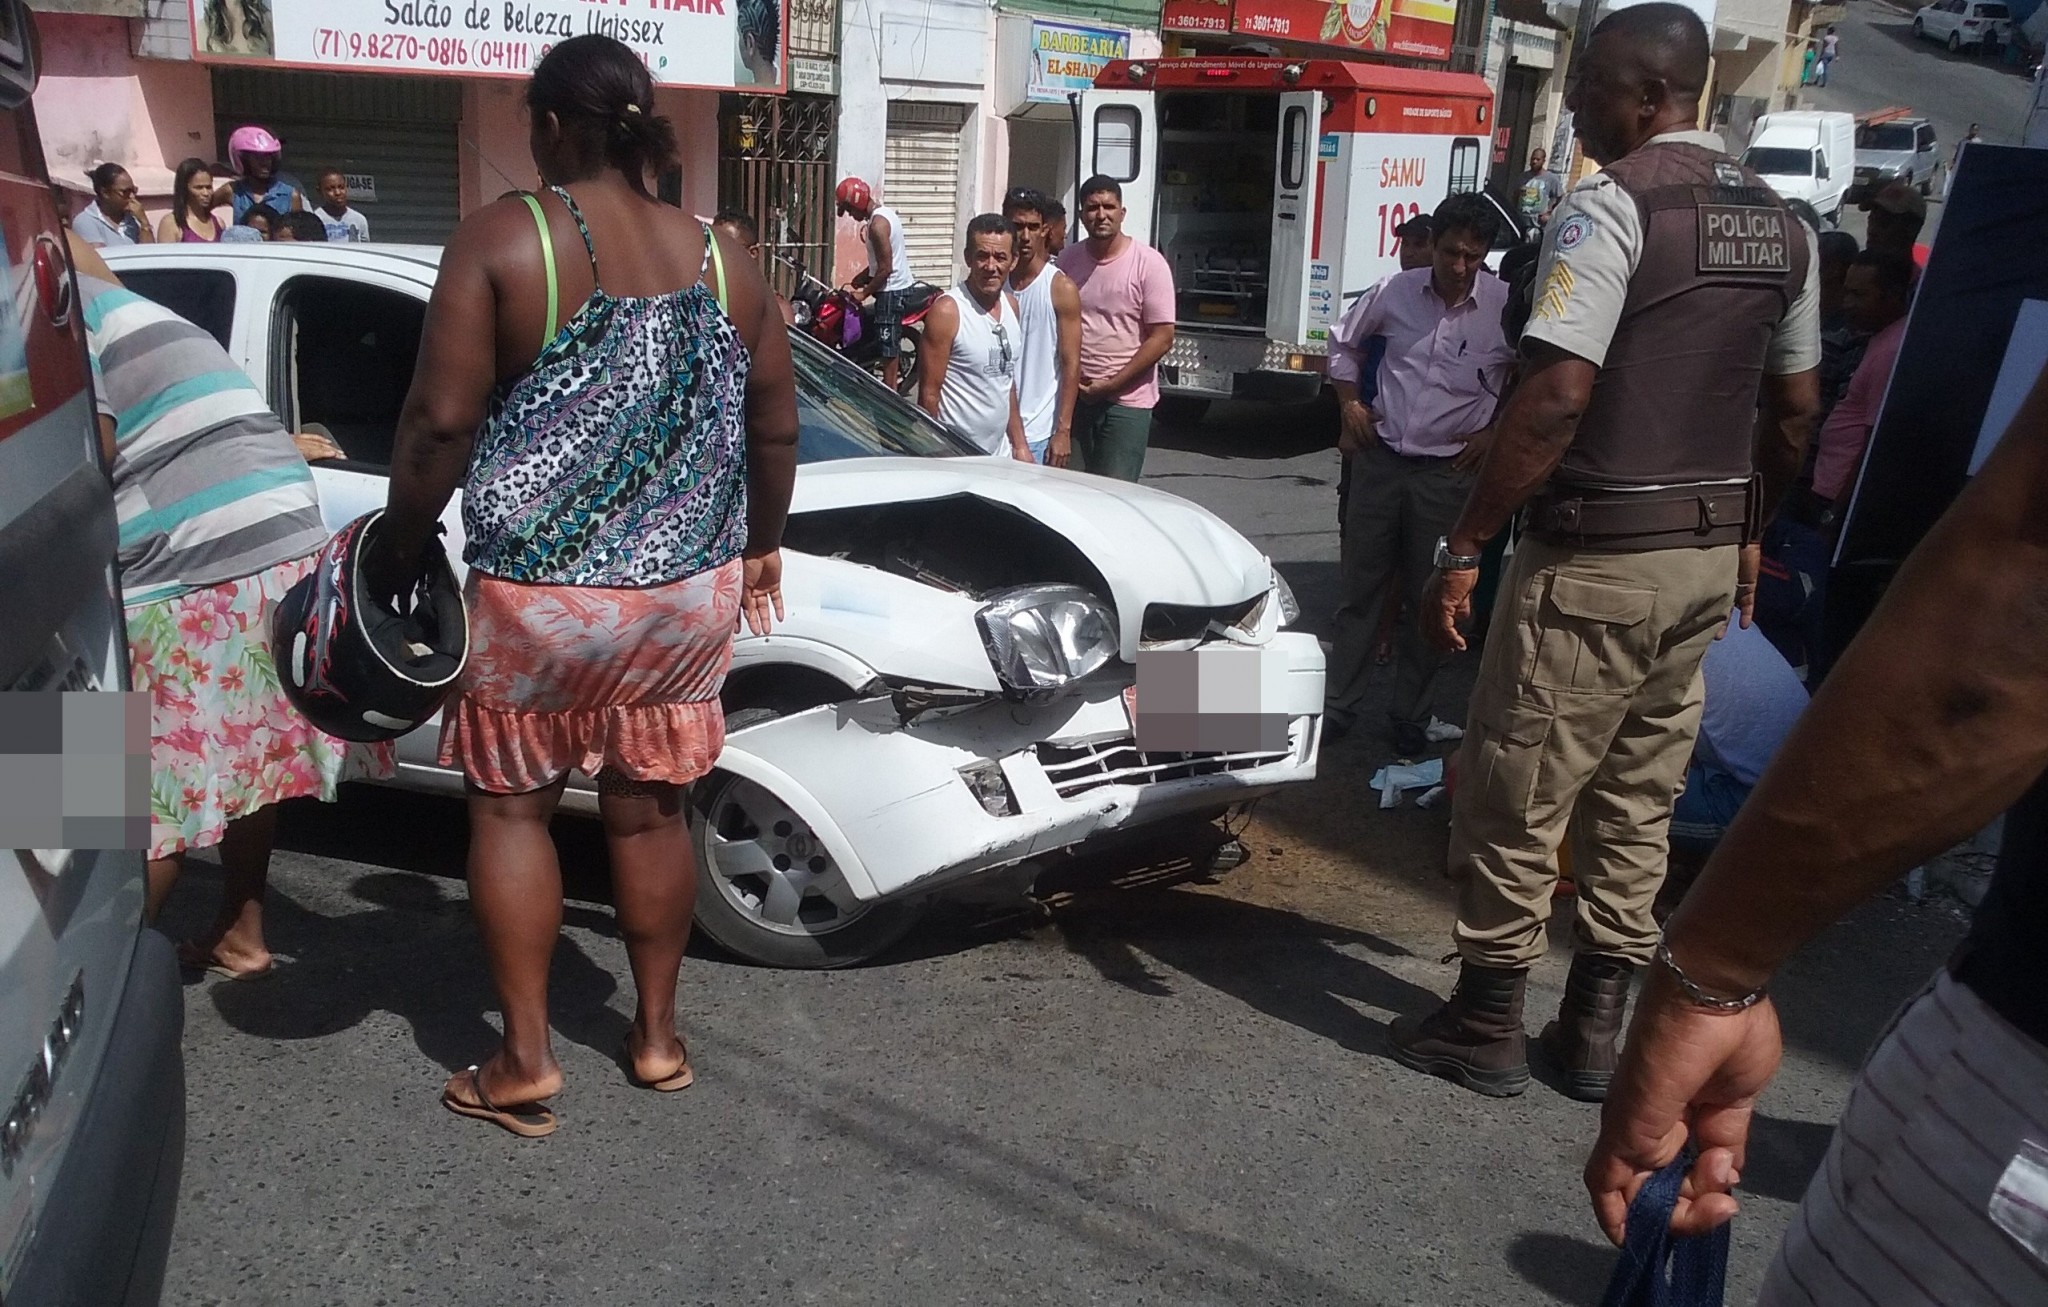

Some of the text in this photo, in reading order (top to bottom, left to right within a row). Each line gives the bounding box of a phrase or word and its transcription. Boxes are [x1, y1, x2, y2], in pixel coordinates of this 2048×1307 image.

[384, 0, 665, 45] Salão de Beleza Unissex
[1167, 15, 1226, 29] 71 3601-7913
[1244, 14, 1290, 35] 71 3601-7913
[1039, 30, 1124, 58] BARBEARIA
[1158, 60, 1283, 70] Serviço de Atendimento Móvel de Urgência
[1379, 157, 1426, 189] SAMU
[1706, 209, 1783, 238] POLÍCIA
[1708, 241, 1784, 266] MILITAR
